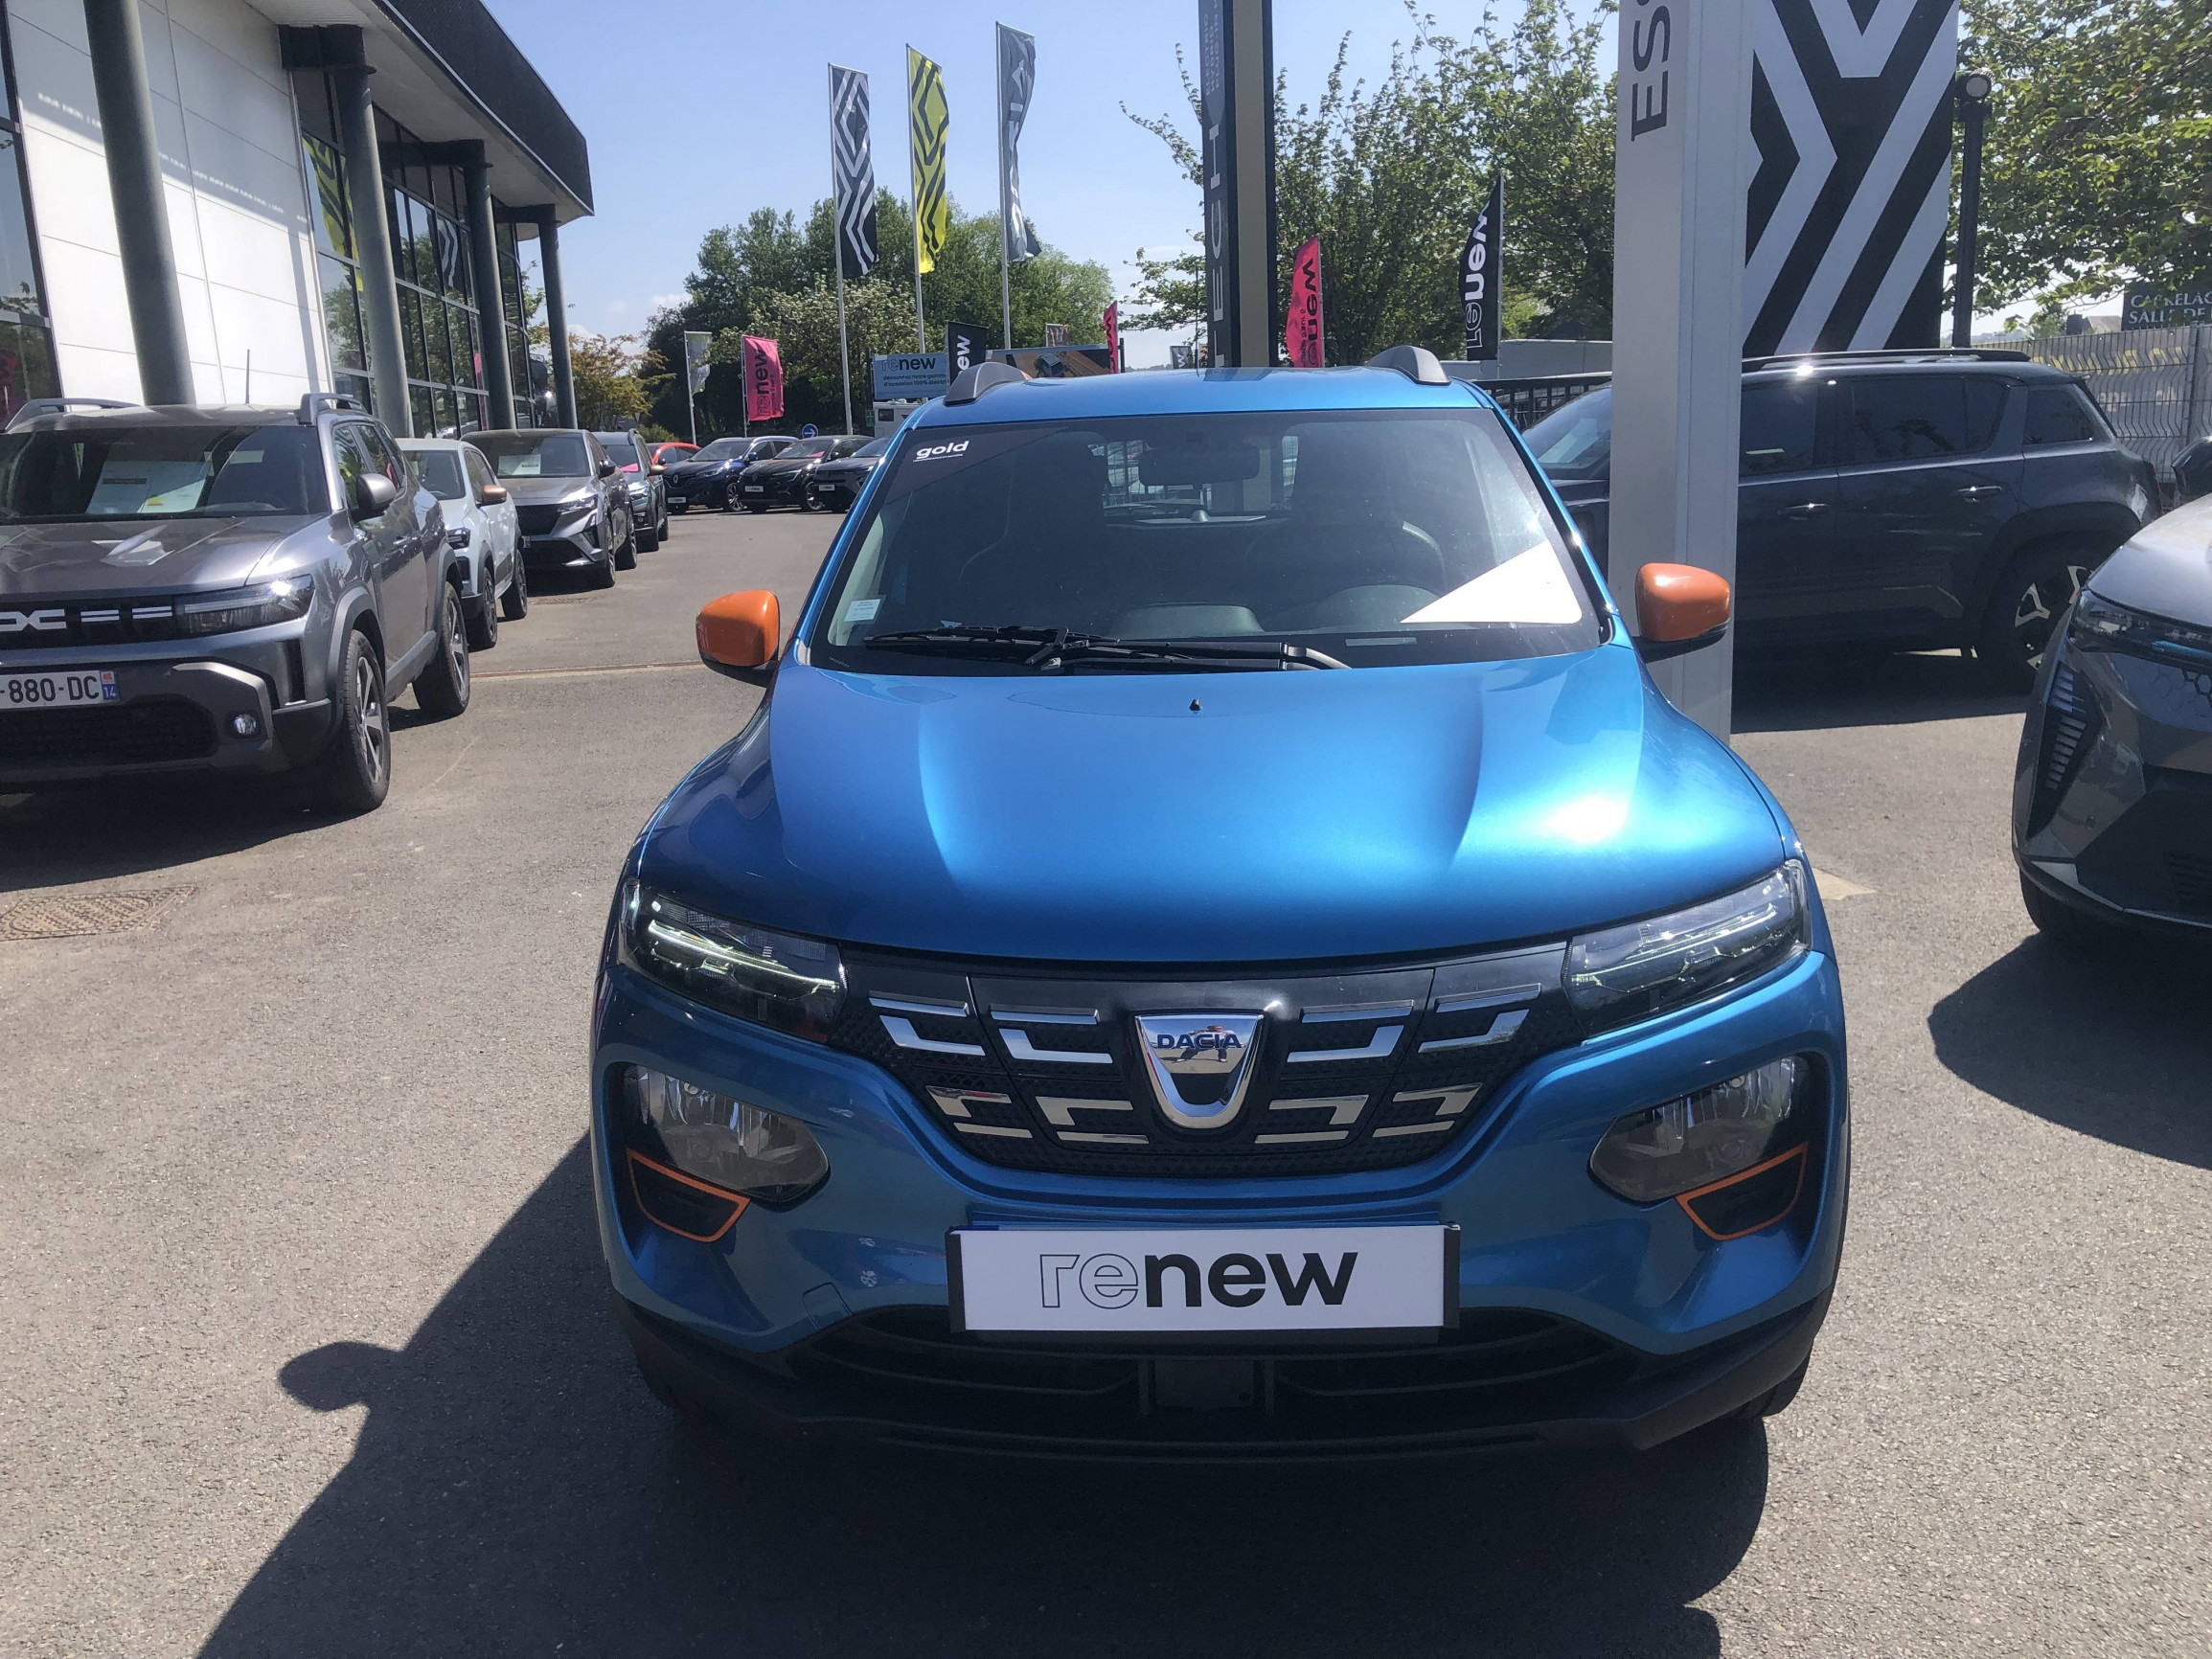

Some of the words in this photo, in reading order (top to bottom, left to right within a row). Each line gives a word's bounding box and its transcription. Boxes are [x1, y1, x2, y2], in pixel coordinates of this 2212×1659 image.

[1631, 0, 1671, 142] ES
[882, 357, 936, 372] renew
[755, 349, 770, 416] renew
[916, 440, 970, 460] gold
[103, 686, 117, 698] 14
[1157, 1034, 1243, 1049] DACIA
[1039, 1251, 1358, 1309] renew
